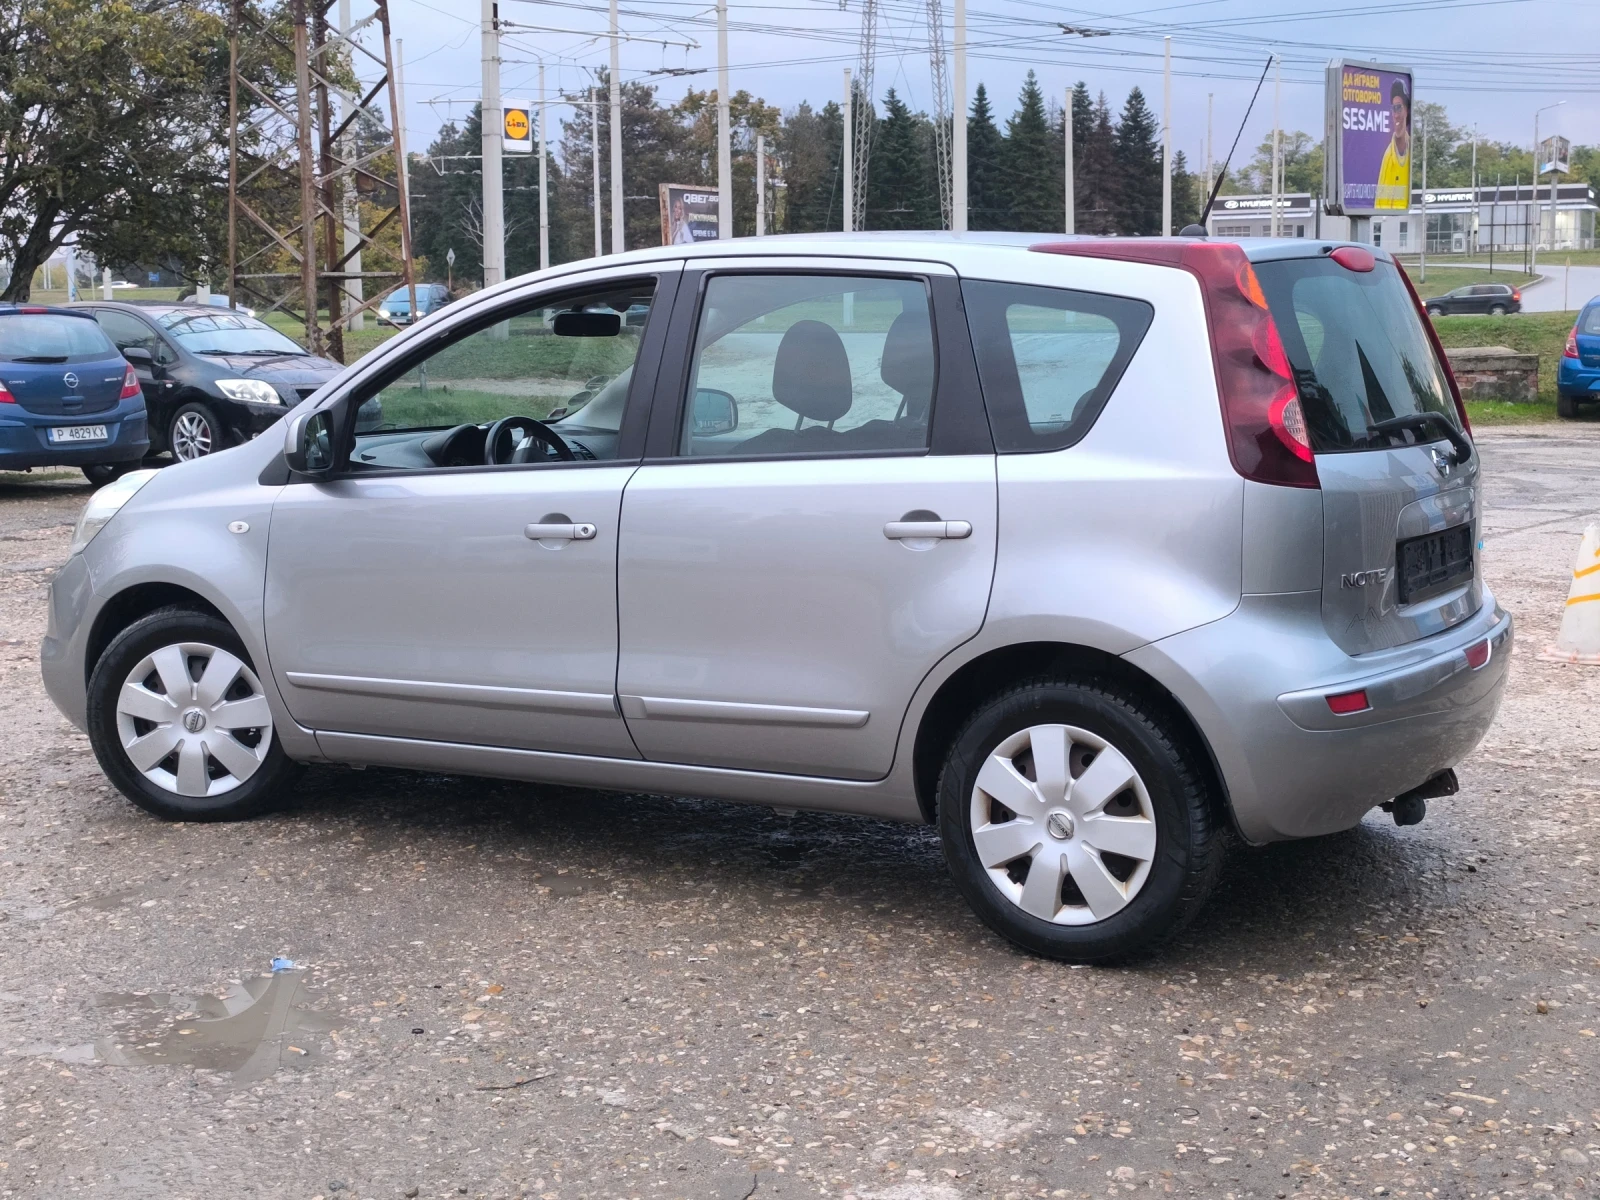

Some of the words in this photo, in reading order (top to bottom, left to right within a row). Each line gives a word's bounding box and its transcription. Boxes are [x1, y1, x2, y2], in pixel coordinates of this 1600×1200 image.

[1343, 72, 1353, 87] ДА
[1354, 73, 1380, 89] ИГРАЕМ
[1343, 88, 1382, 105] ОТГОВОРНО
[1343, 107, 1390, 133] SESAME
[1437, 193, 1473, 202] HYUNDA
[57, 429, 64, 440] P
[1340, 568, 1386, 589] NOTE
